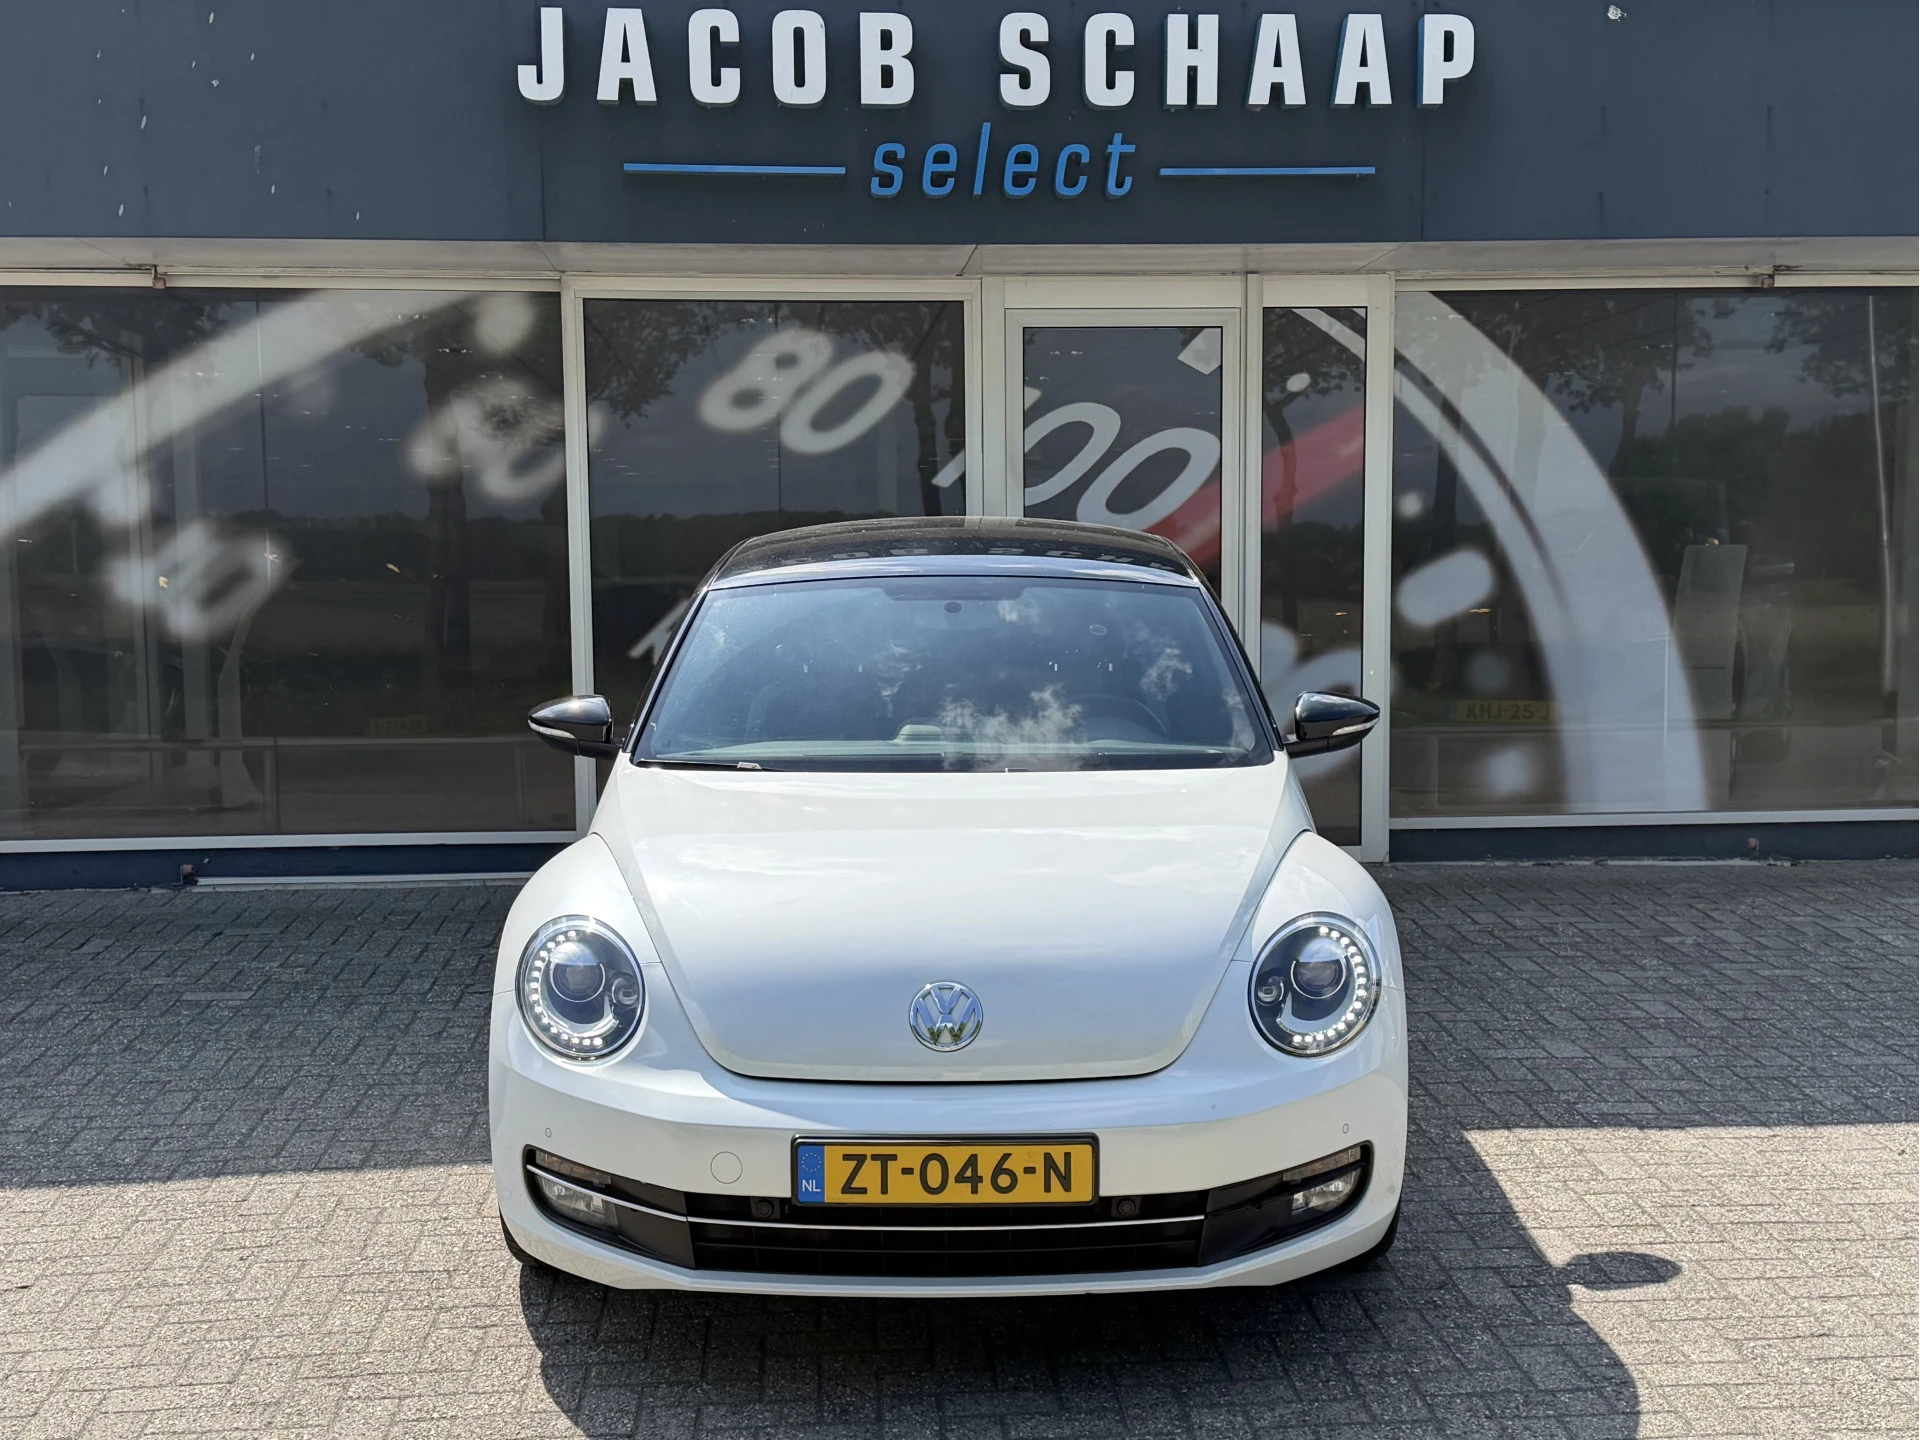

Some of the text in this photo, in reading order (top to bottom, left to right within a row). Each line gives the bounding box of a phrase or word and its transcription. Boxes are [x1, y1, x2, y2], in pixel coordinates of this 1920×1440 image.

[516, 6, 1477, 109] JACOB SCHAAP
[869, 121, 1137, 199] select
[698, 326, 916, 456] 80
[801, 1179, 822, 1193] NL
[840, 1151, 1073, 1196] ZT-046-N
